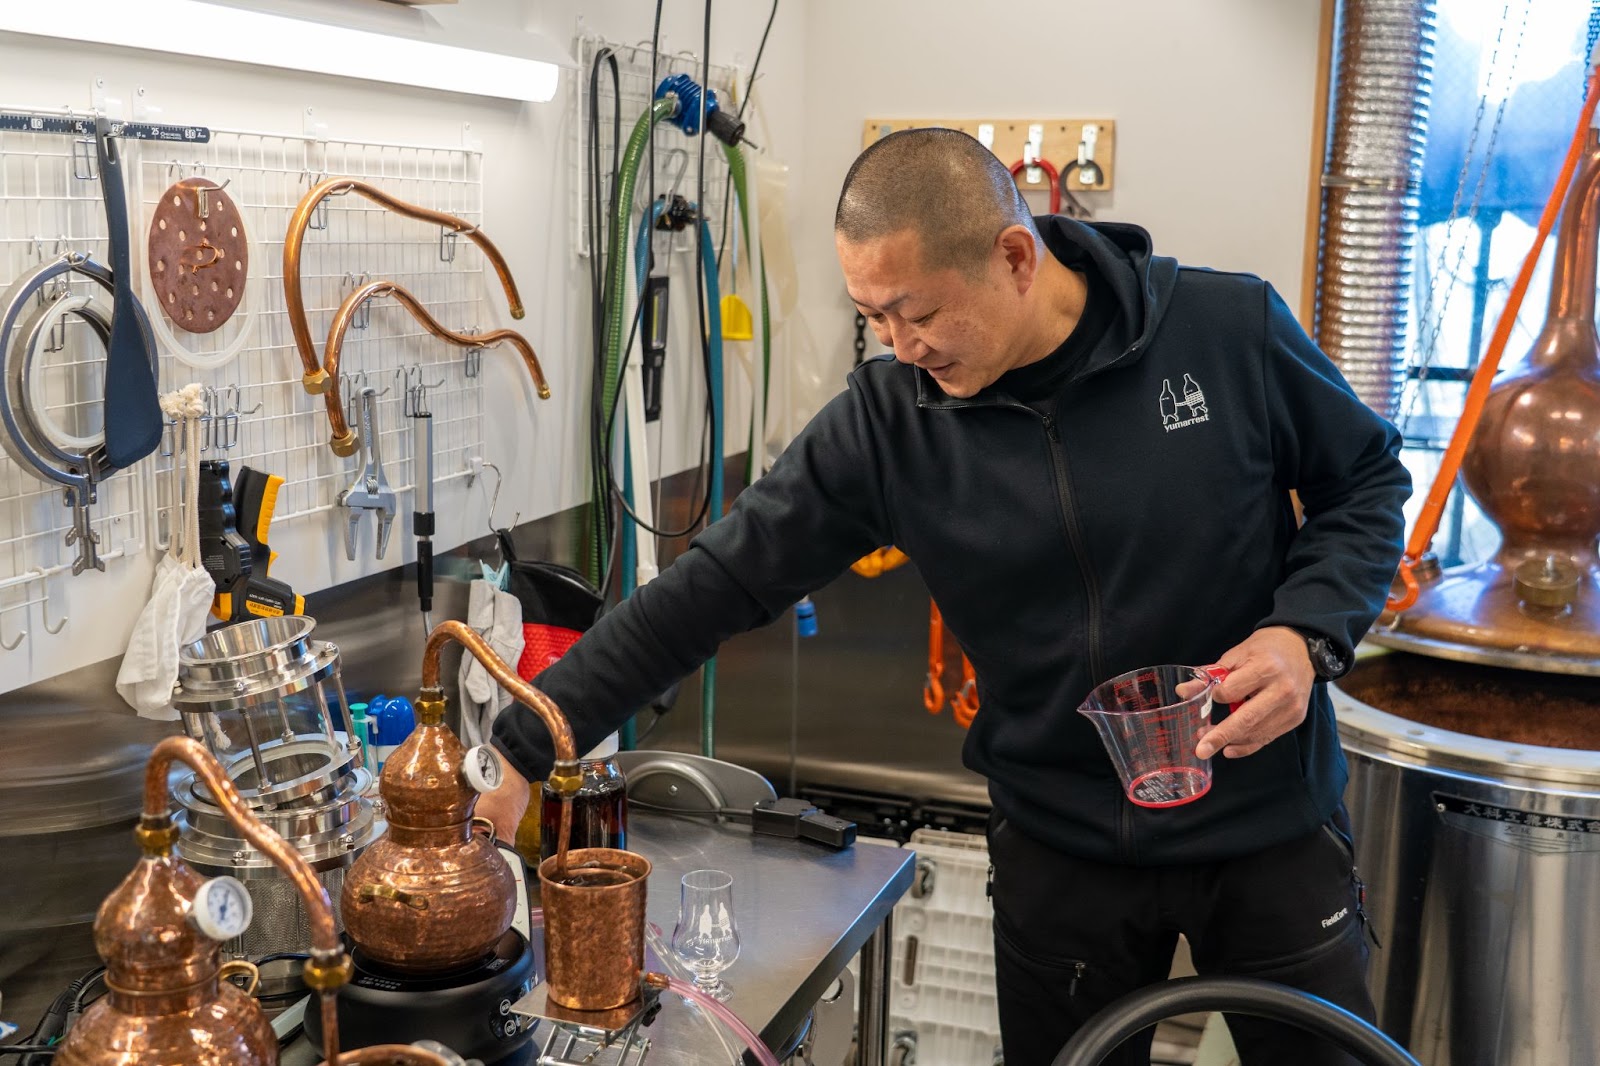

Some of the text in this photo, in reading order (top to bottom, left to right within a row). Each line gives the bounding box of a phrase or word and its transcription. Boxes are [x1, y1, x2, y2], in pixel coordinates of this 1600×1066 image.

[31, 119, 44, 129] 10
[75, 121, 83, 131] 15
[151, 127, 160, 136] 25
[184, 129, 197, 139] 30
[1164, 414, 1209, 433] yumarrest
